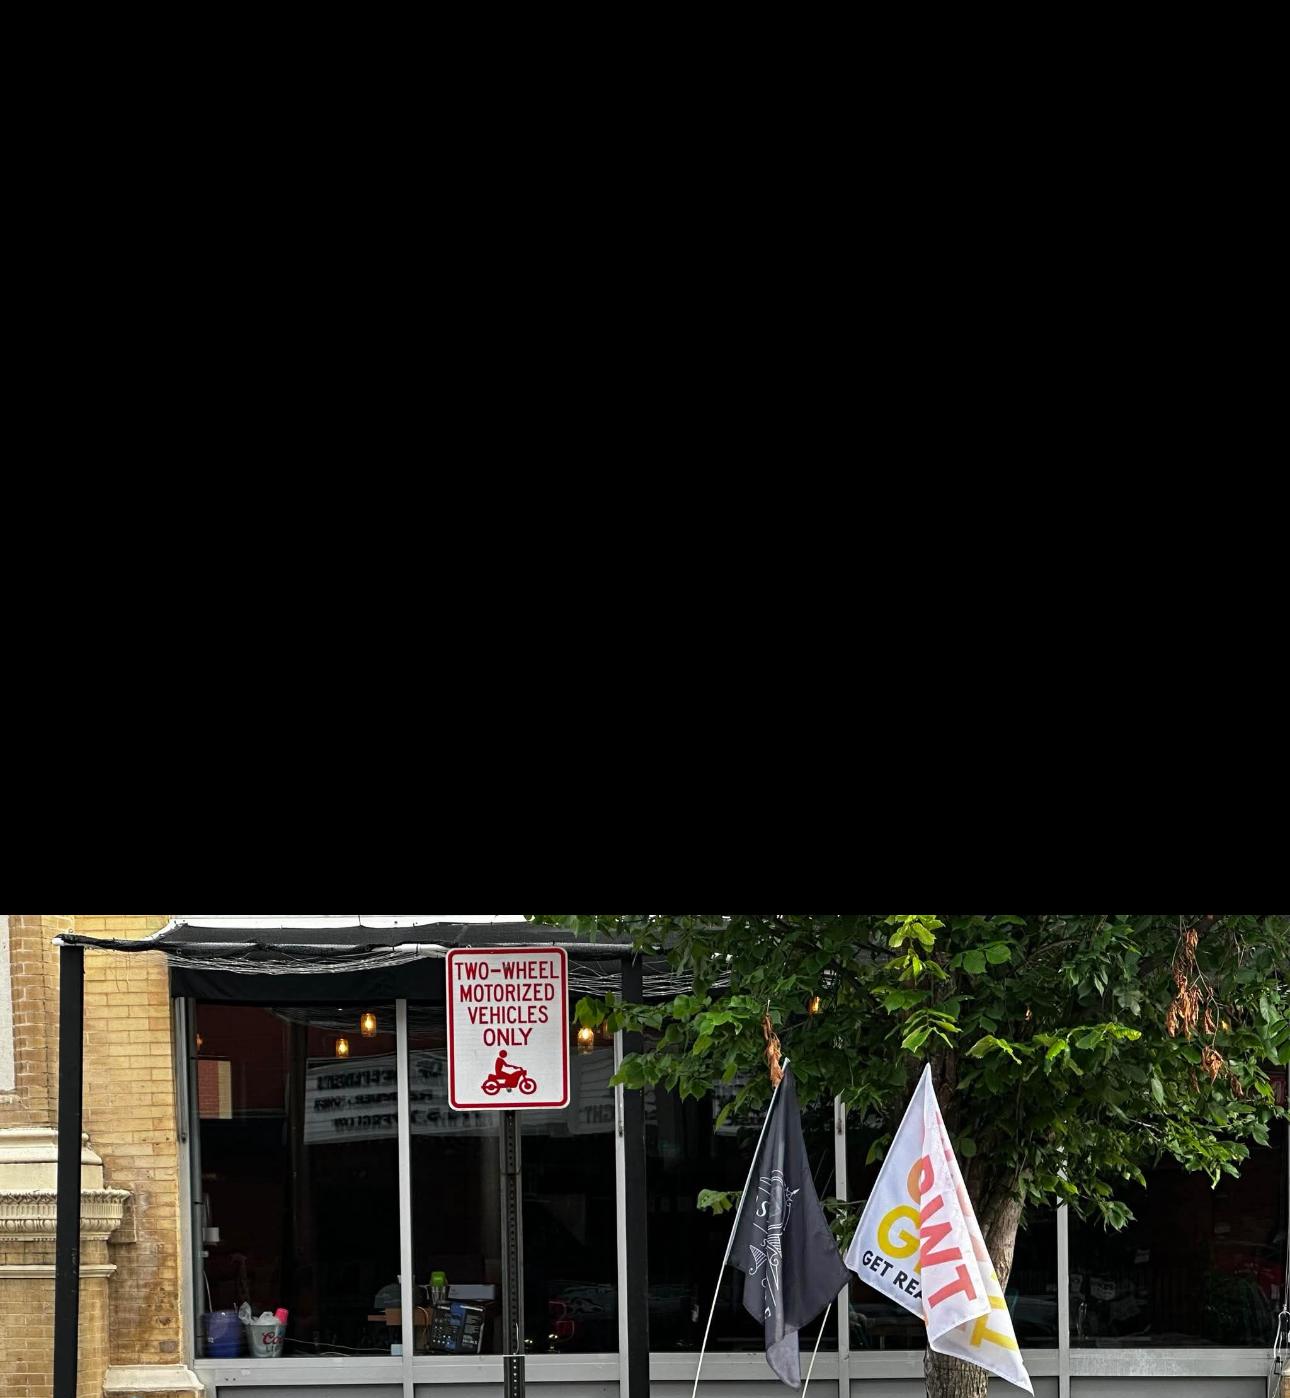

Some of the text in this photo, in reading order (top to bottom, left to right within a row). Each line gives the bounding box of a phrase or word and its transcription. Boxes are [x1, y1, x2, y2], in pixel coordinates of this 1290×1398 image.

[455, 961, 559, 980] TWO-WHEEL
[460, 984, 555, 1002] MOTORIZED
[468, 1006, 549, 1024] VEHICLES
[483, 1028, 533, 1046] ONLY
[862, 1250, 894, 1277] GET
